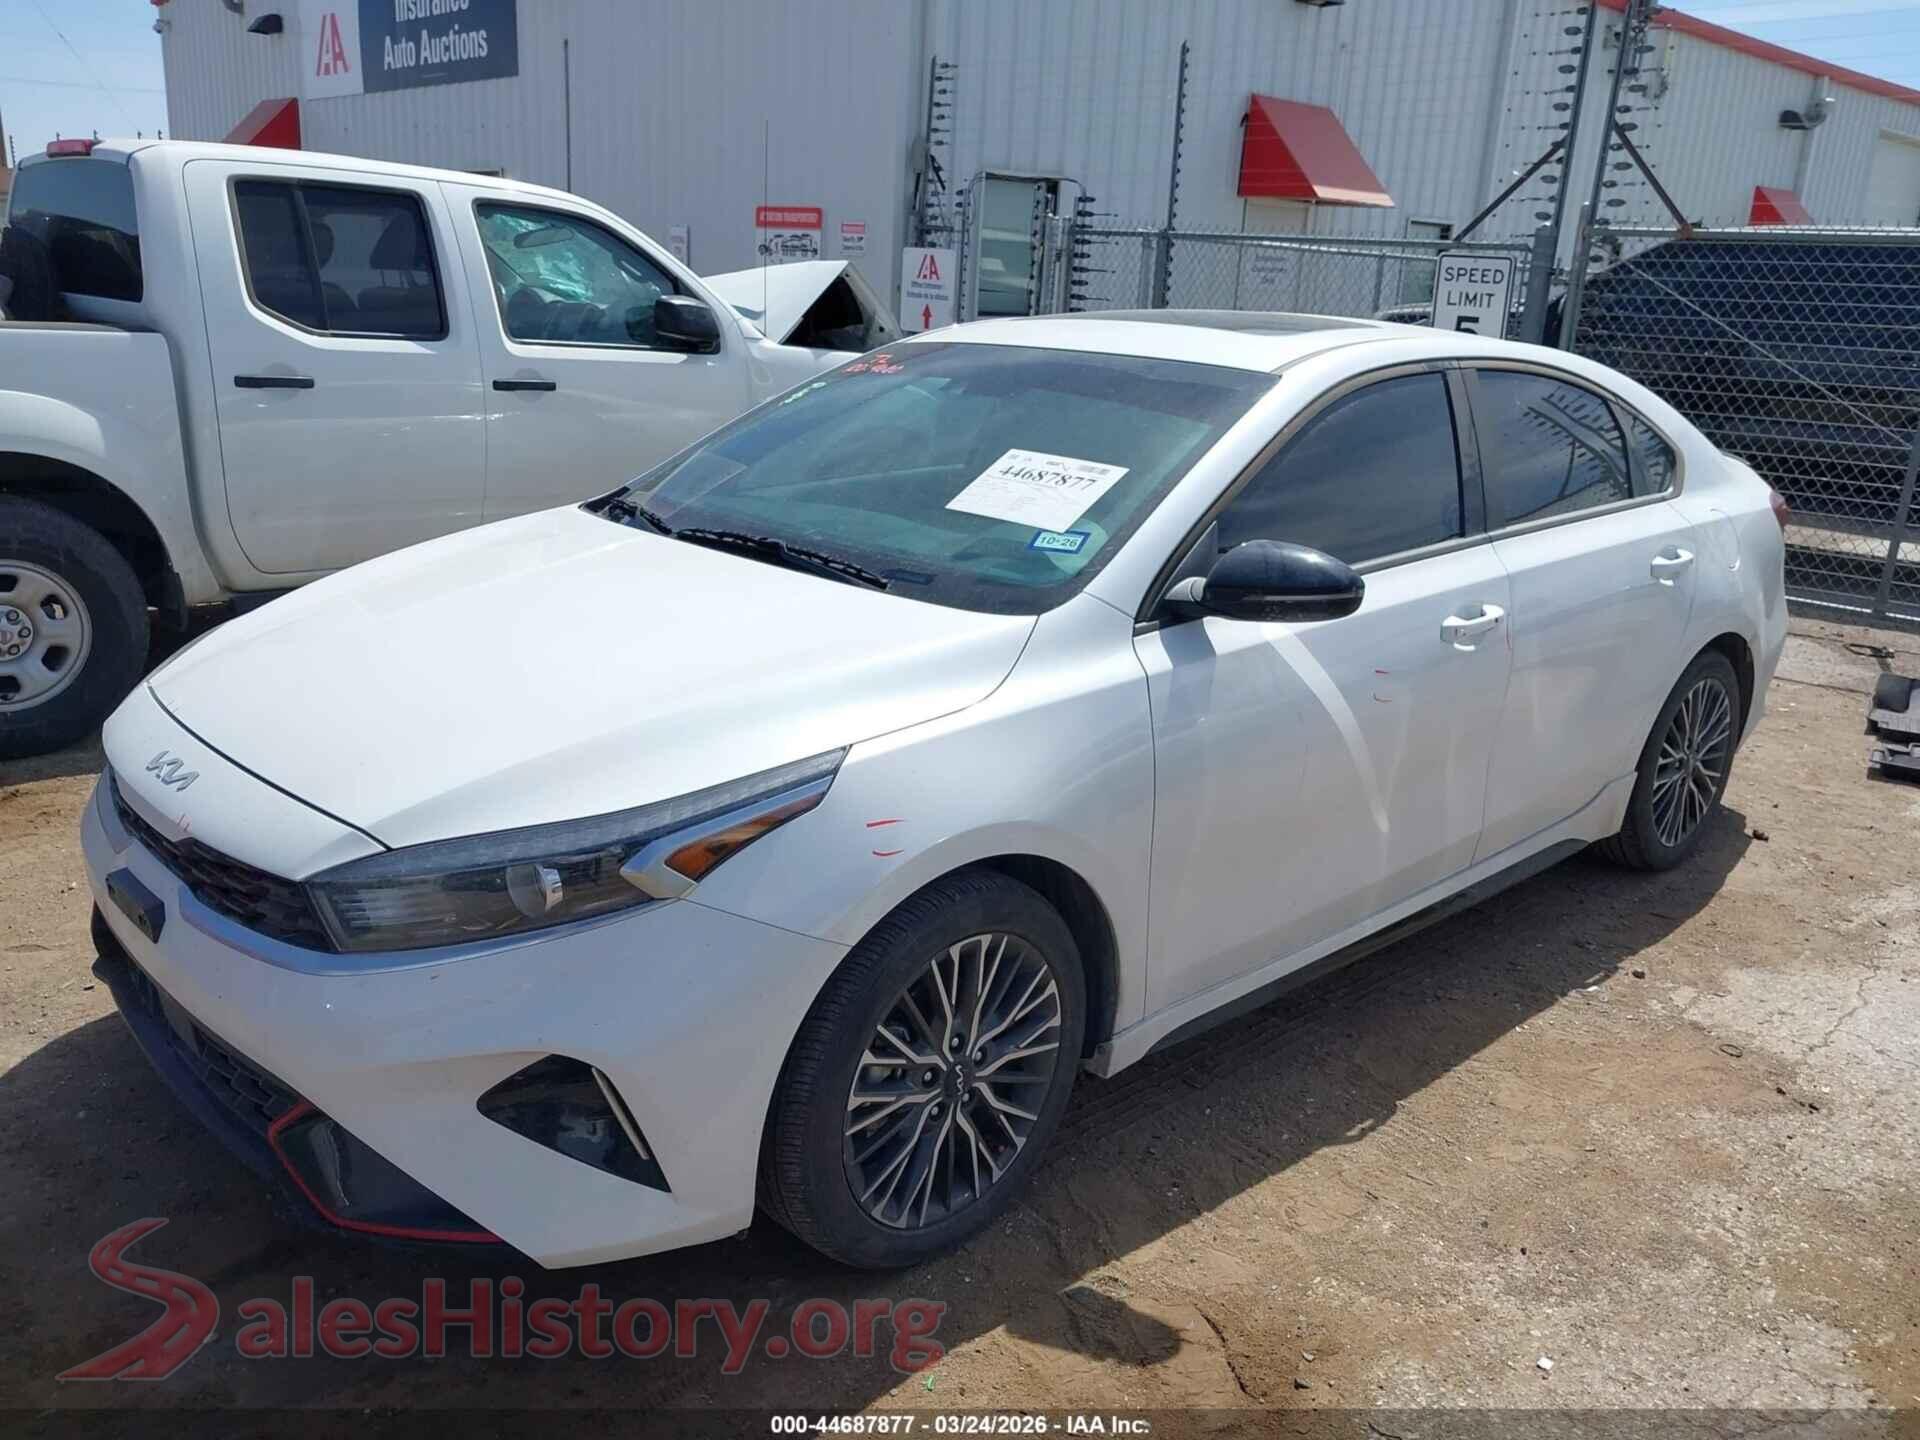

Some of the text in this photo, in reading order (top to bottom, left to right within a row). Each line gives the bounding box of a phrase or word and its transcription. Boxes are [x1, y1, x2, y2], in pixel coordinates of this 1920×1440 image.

[384, 23, 488, 71] Auto Auctions
[1444, 267, 1505, 285] SPEED
[1447, 290, 1495, 308] LIMIT
[999, 465, 1098, 491] 44687877
[1039, 535, 1079, 548] 10-26
